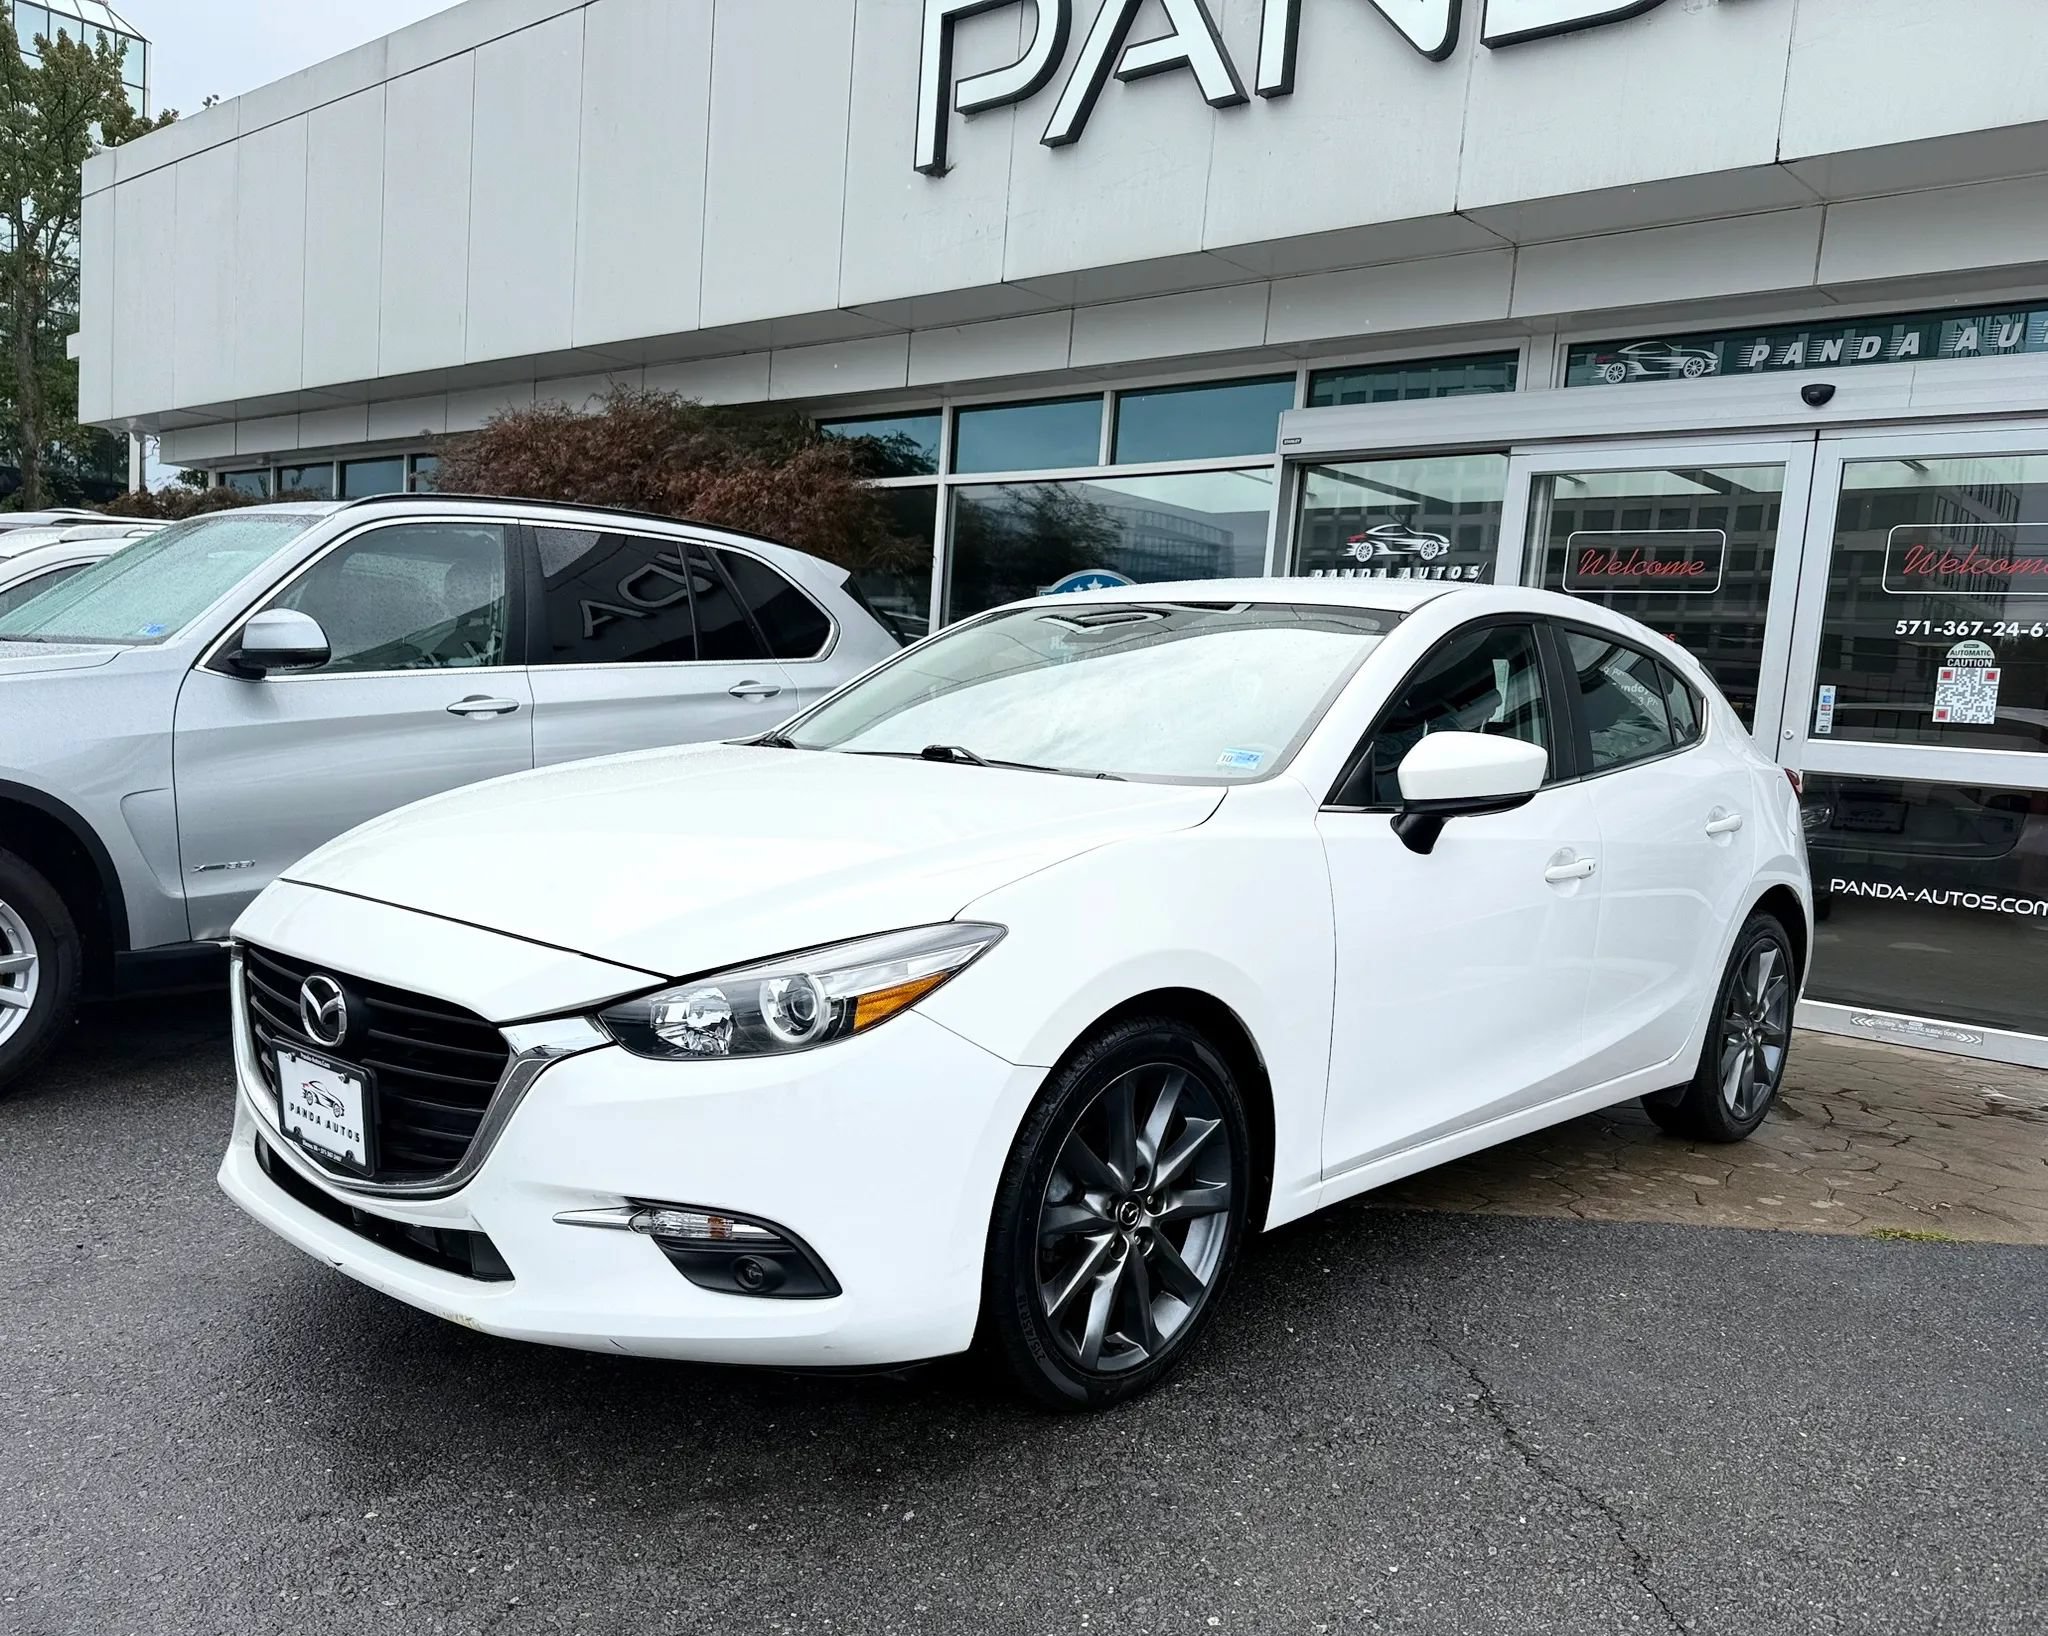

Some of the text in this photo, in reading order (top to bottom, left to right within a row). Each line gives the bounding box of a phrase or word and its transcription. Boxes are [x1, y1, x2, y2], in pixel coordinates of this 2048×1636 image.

[1737, 331, 1920, 368] PANDA
[1579, 547, 1706, 576] Welcome
[1398, 565, 1479, 580] AUTOS
[1895, 620, 2048, 638] 571-367-24-6
[1950, 649, 1991, 657] AUTOMATIC
[1946, 658, 1993, 668] CAUTION
[289, 1102, 360, 1143] PANDA AUTOS
